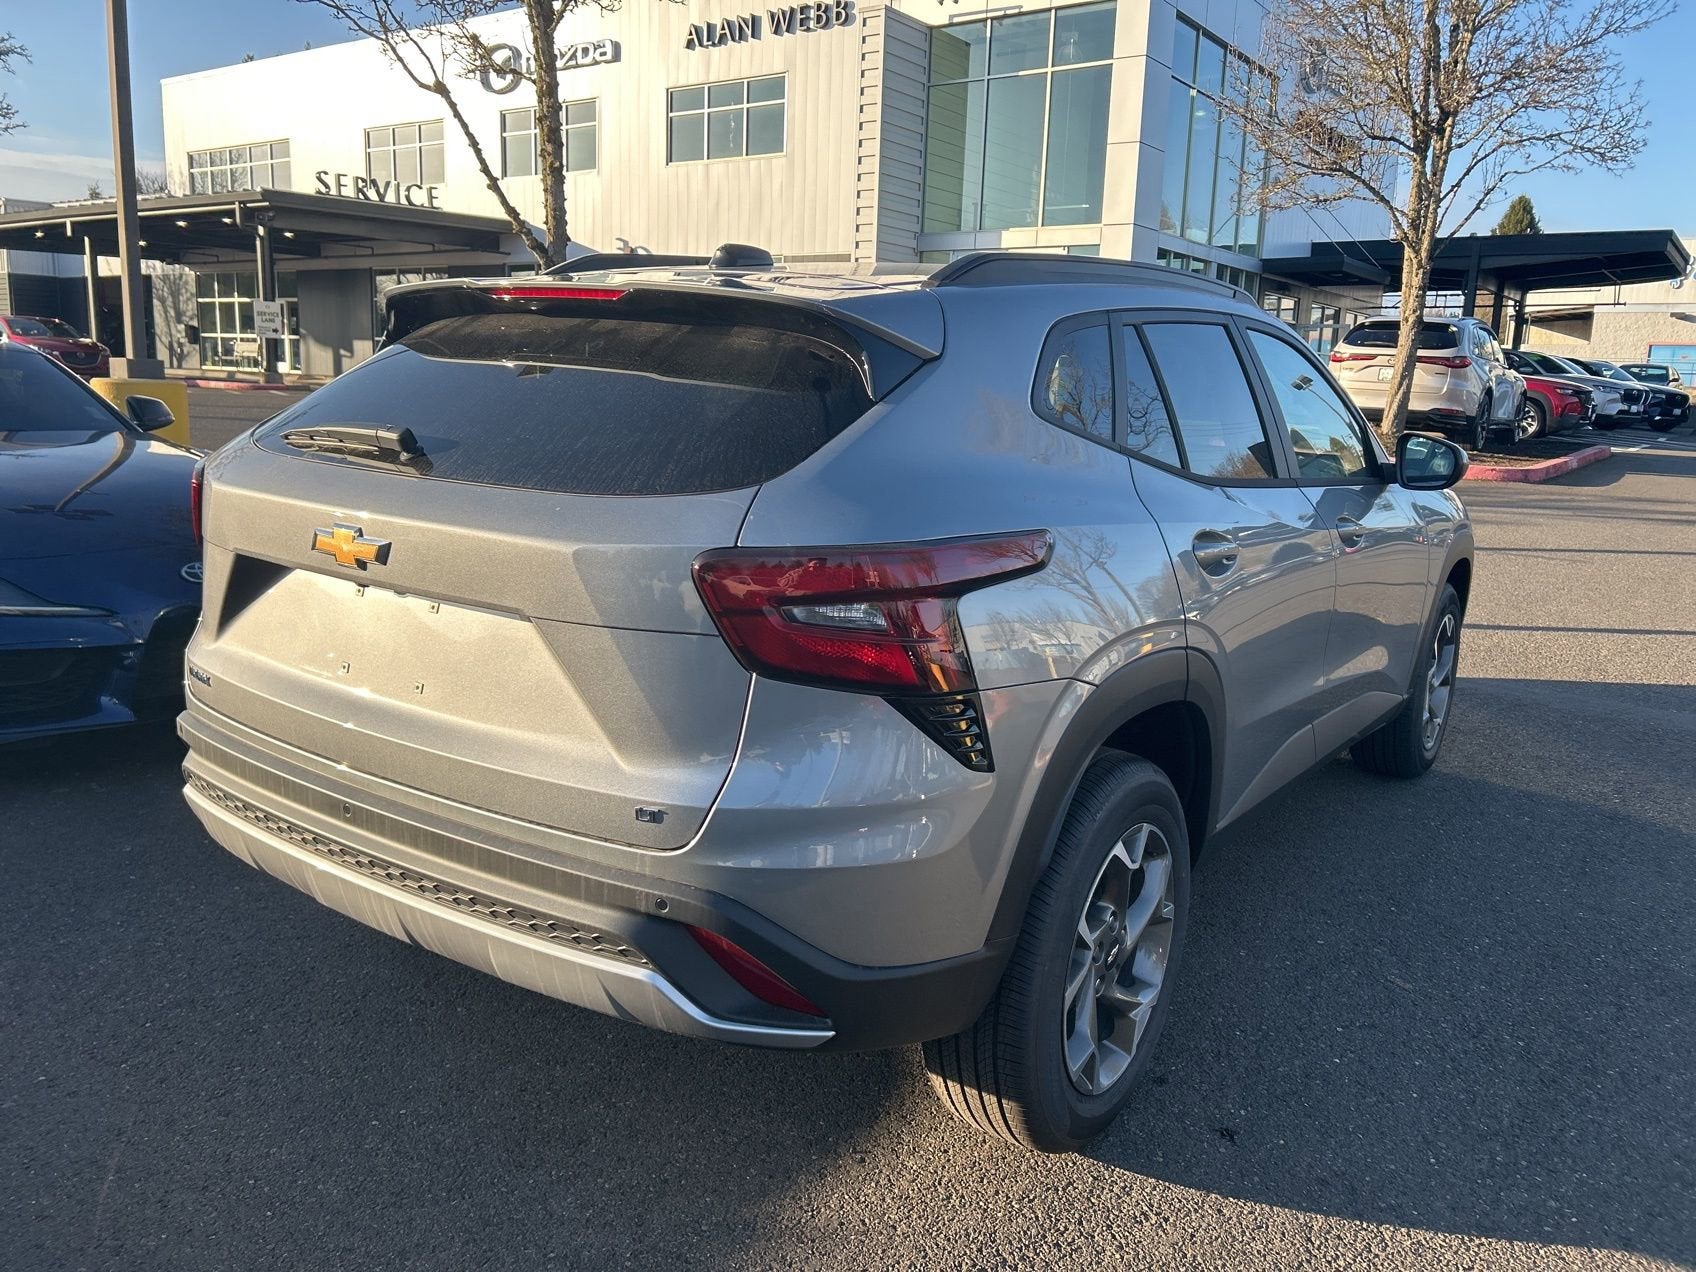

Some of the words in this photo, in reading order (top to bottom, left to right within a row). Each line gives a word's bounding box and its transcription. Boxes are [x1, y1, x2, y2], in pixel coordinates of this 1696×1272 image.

[684, 14, 762, 51] ALAN
[766, 0, 855, 37] WEBB
[521, 39, 621, 75] mzda
[315, 170, 443, 210] SERVICE
